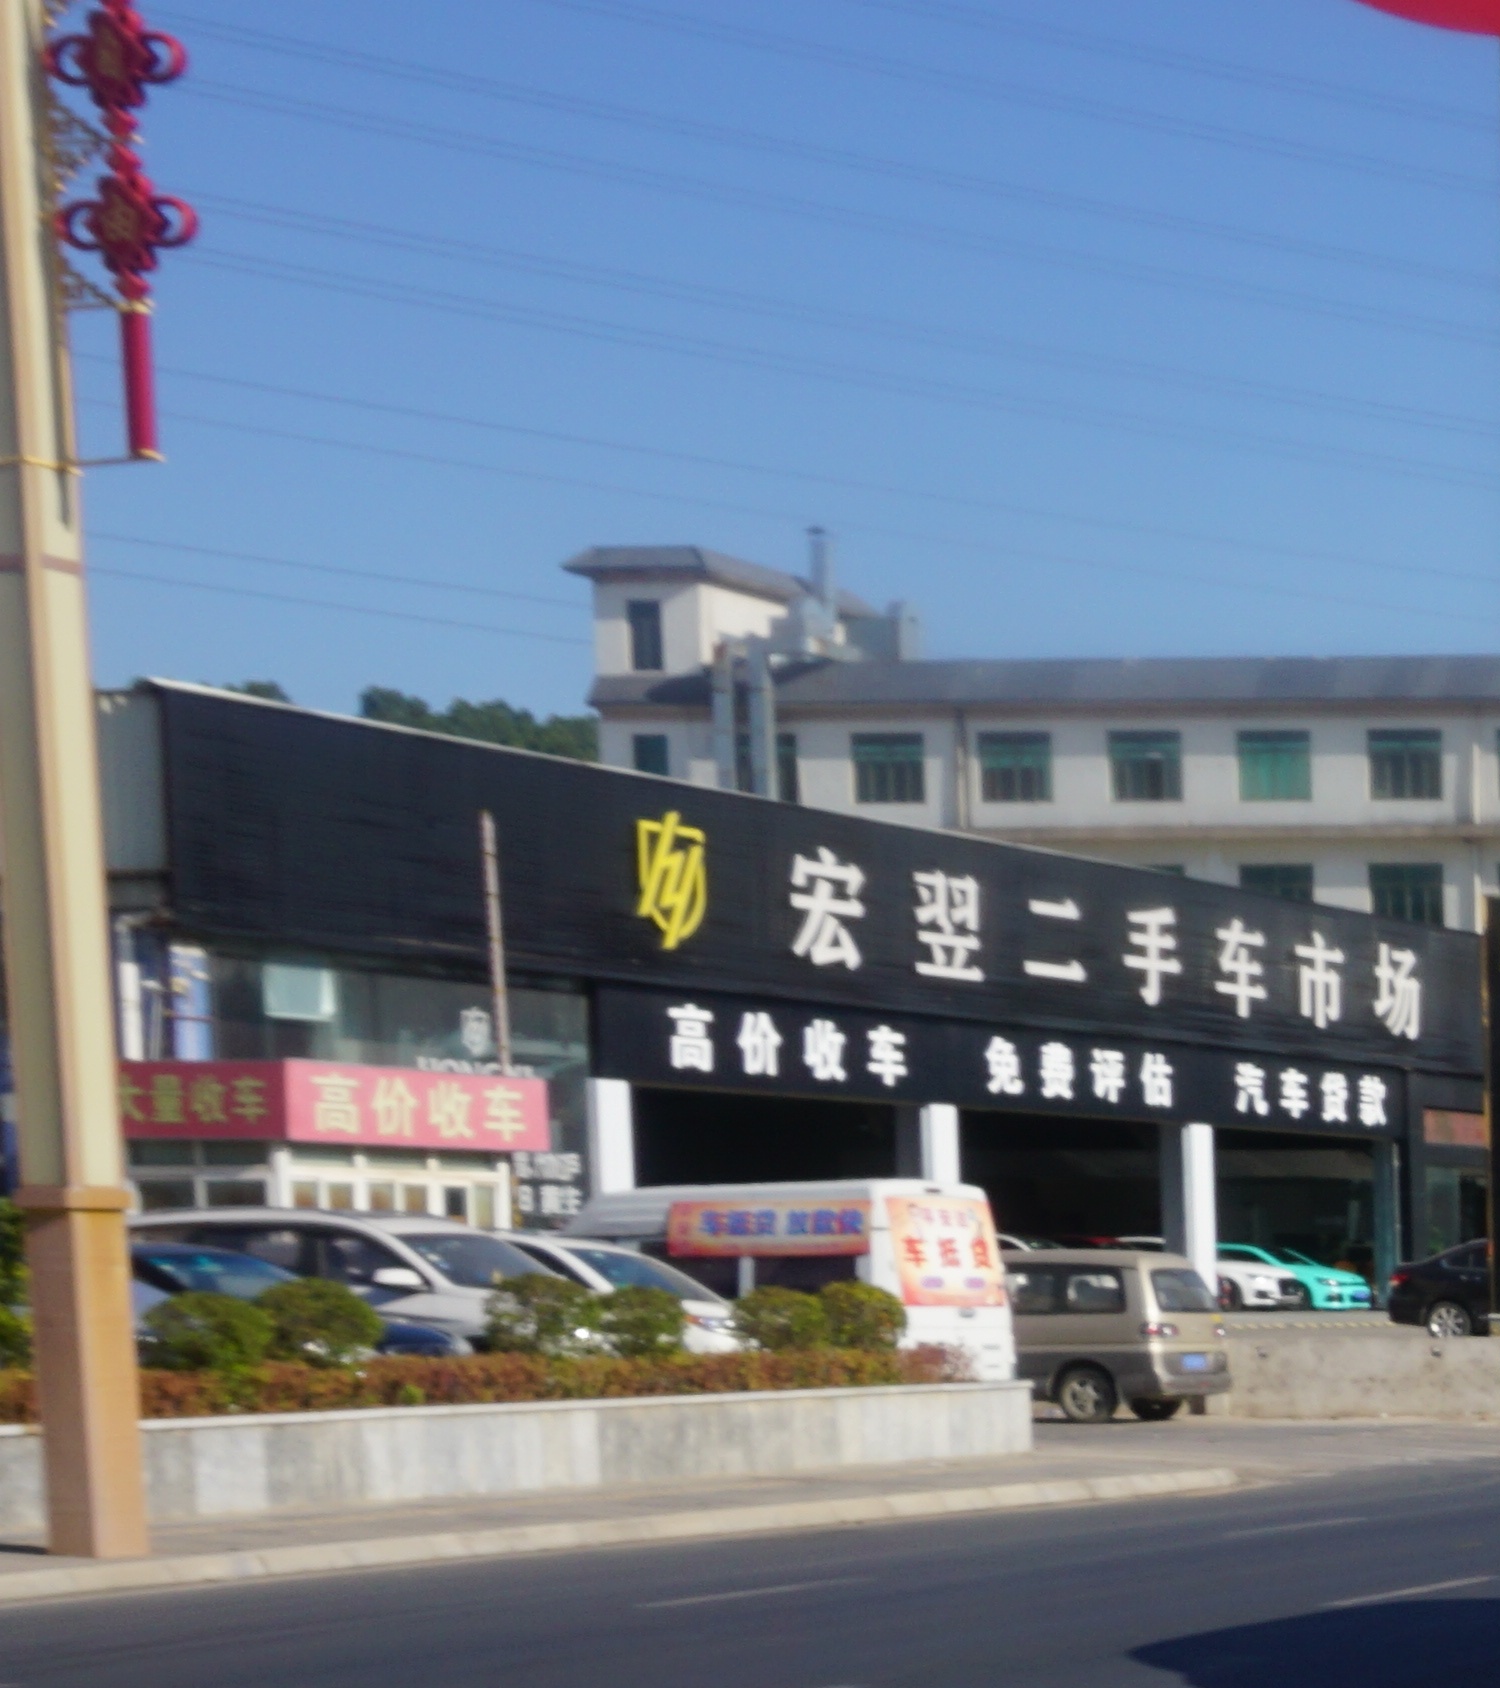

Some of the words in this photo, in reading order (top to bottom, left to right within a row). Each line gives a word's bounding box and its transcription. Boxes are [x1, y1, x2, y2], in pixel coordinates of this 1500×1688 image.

[790, 845, 1422, 1042] 宏翌二手车市场
[117, 1072, 269, 1126] 大量收车
[309, 1071, 527, 1141] 高价收车
[668, 1003, 909, 1088] 高价收车
[984, 1036, 1175, 1109] 免费评估
[1233, 1060, 1388, 1128] 汽车贷款
